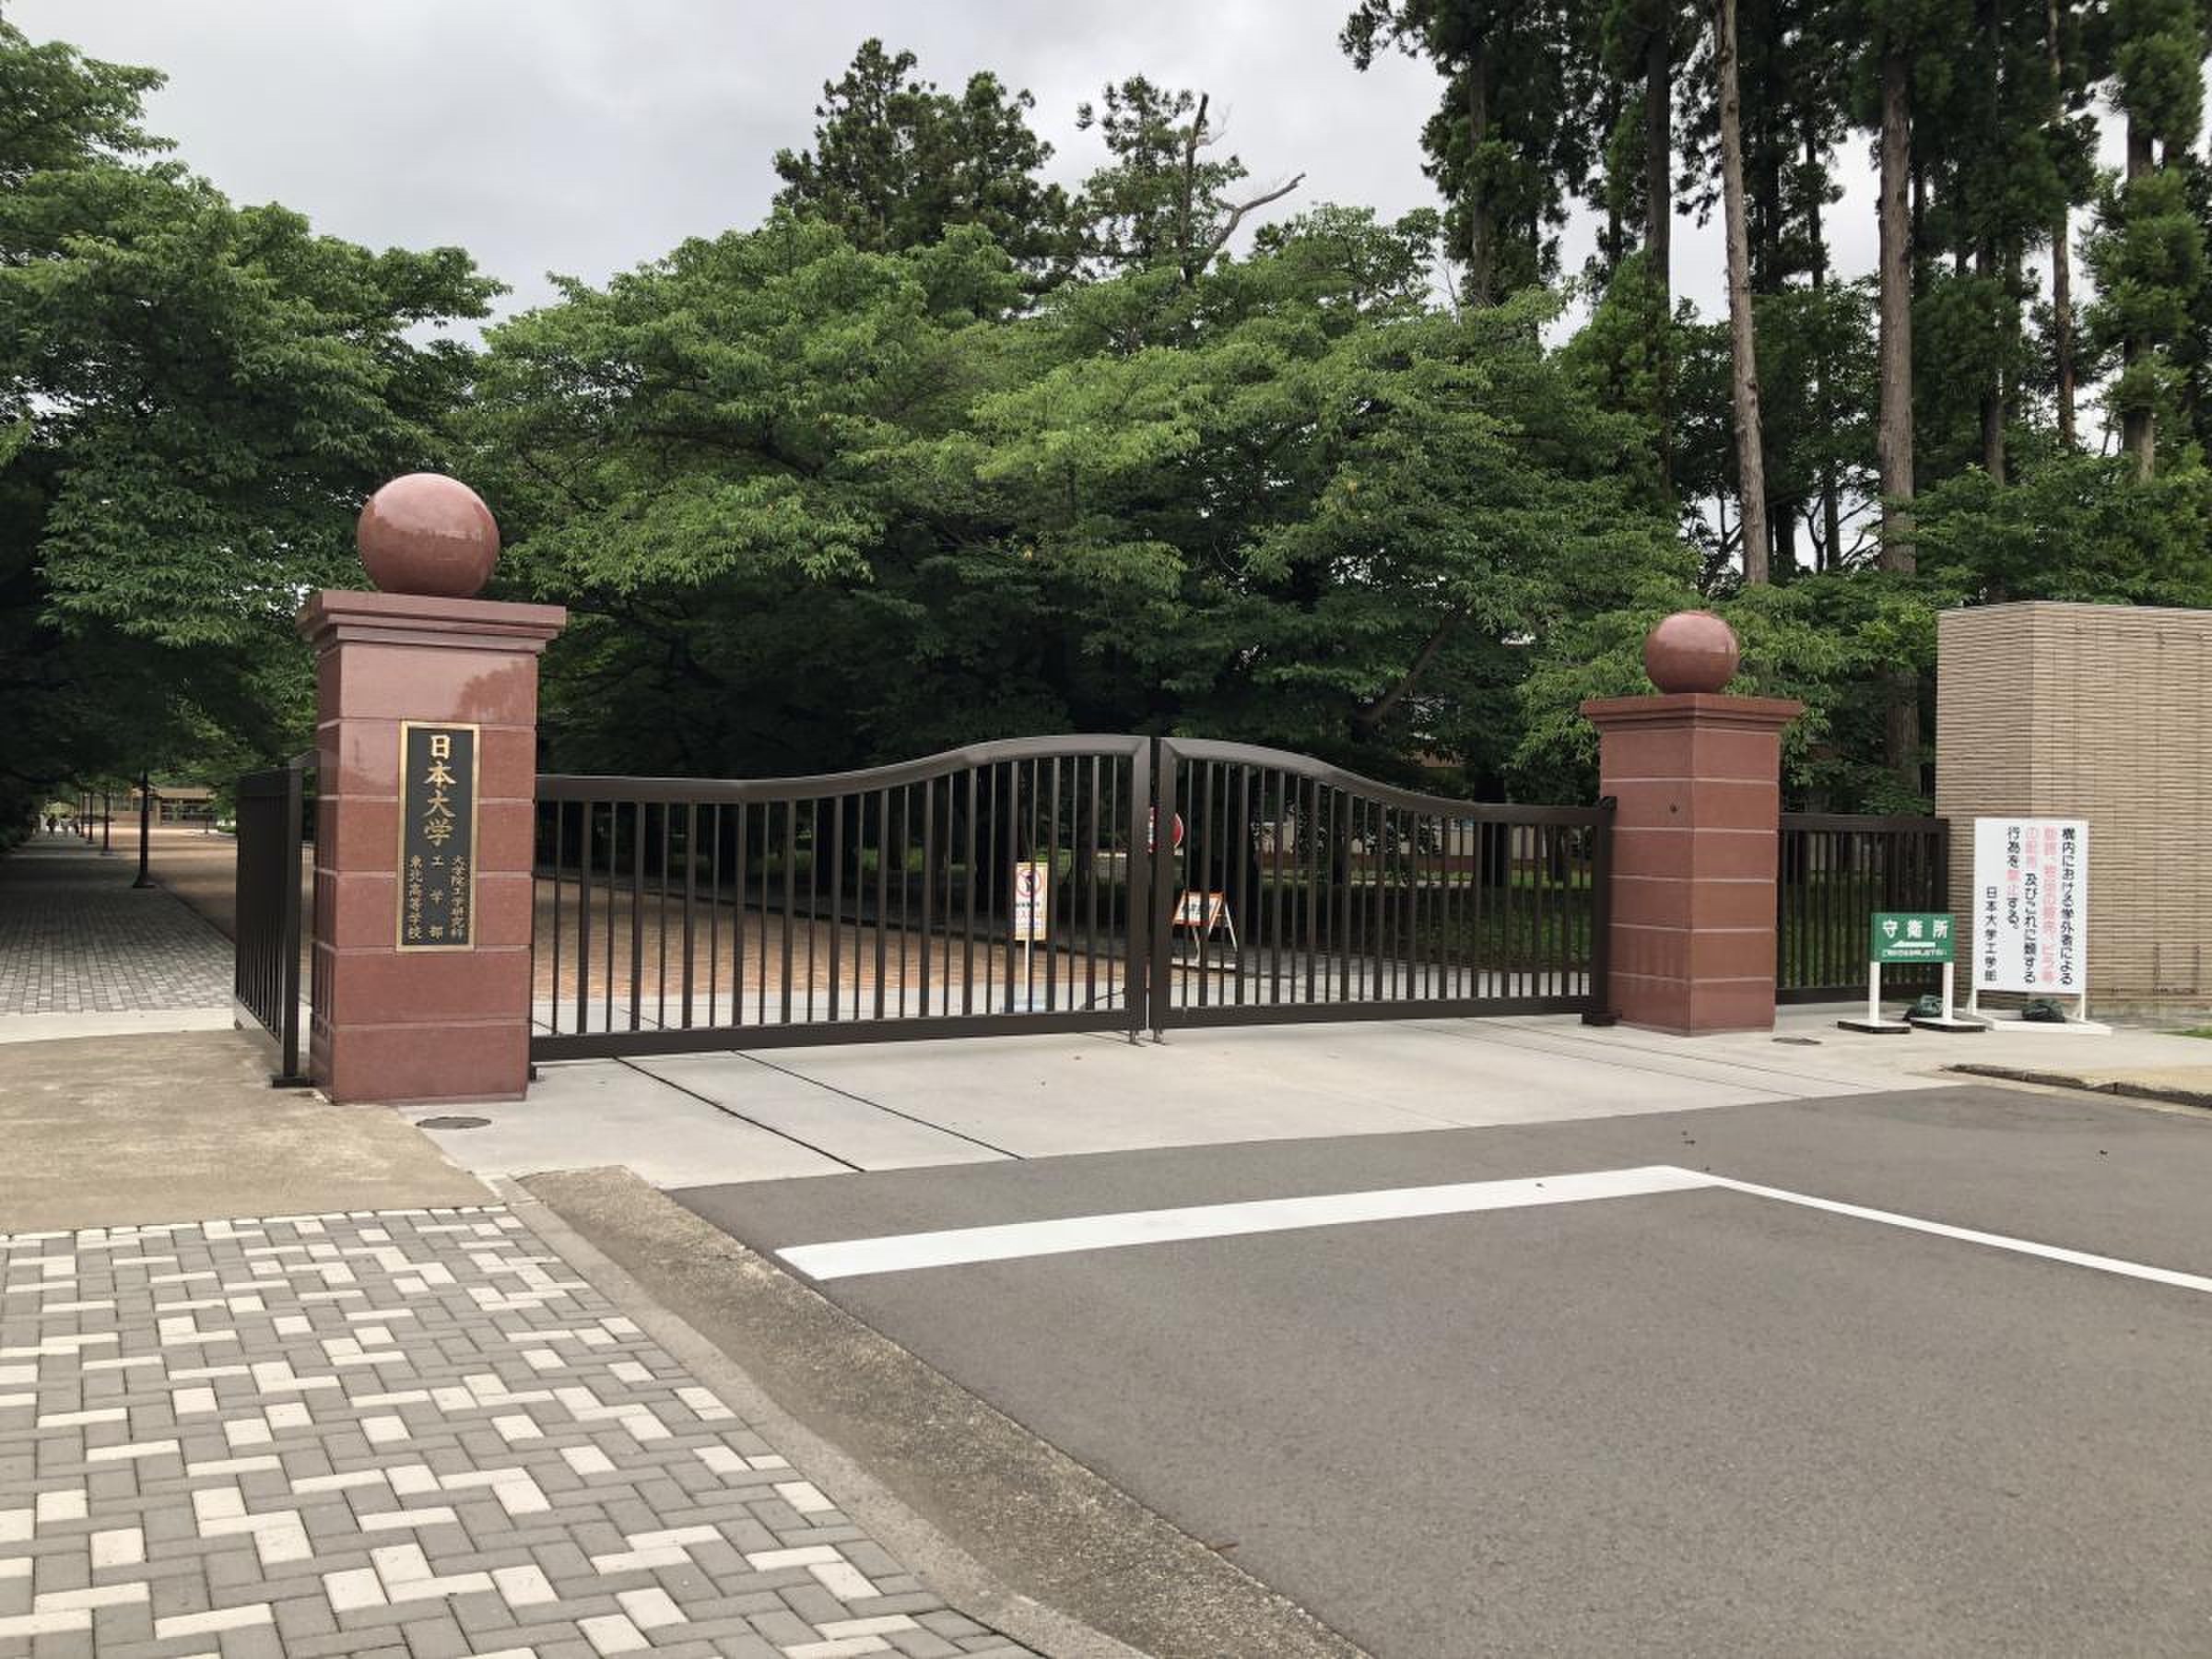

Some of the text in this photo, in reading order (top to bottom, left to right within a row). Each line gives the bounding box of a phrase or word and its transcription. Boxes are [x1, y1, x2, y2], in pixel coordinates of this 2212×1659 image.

[423, 735, 457, 846] 日本大学
[429, 855, 444, 938] 工学部
[2006, 826, 2021, 930] 行為を止する。
[1882, 919, 1947, 938] 守衛所
[1984, 886, 1998, 982] 日本大学工学部
